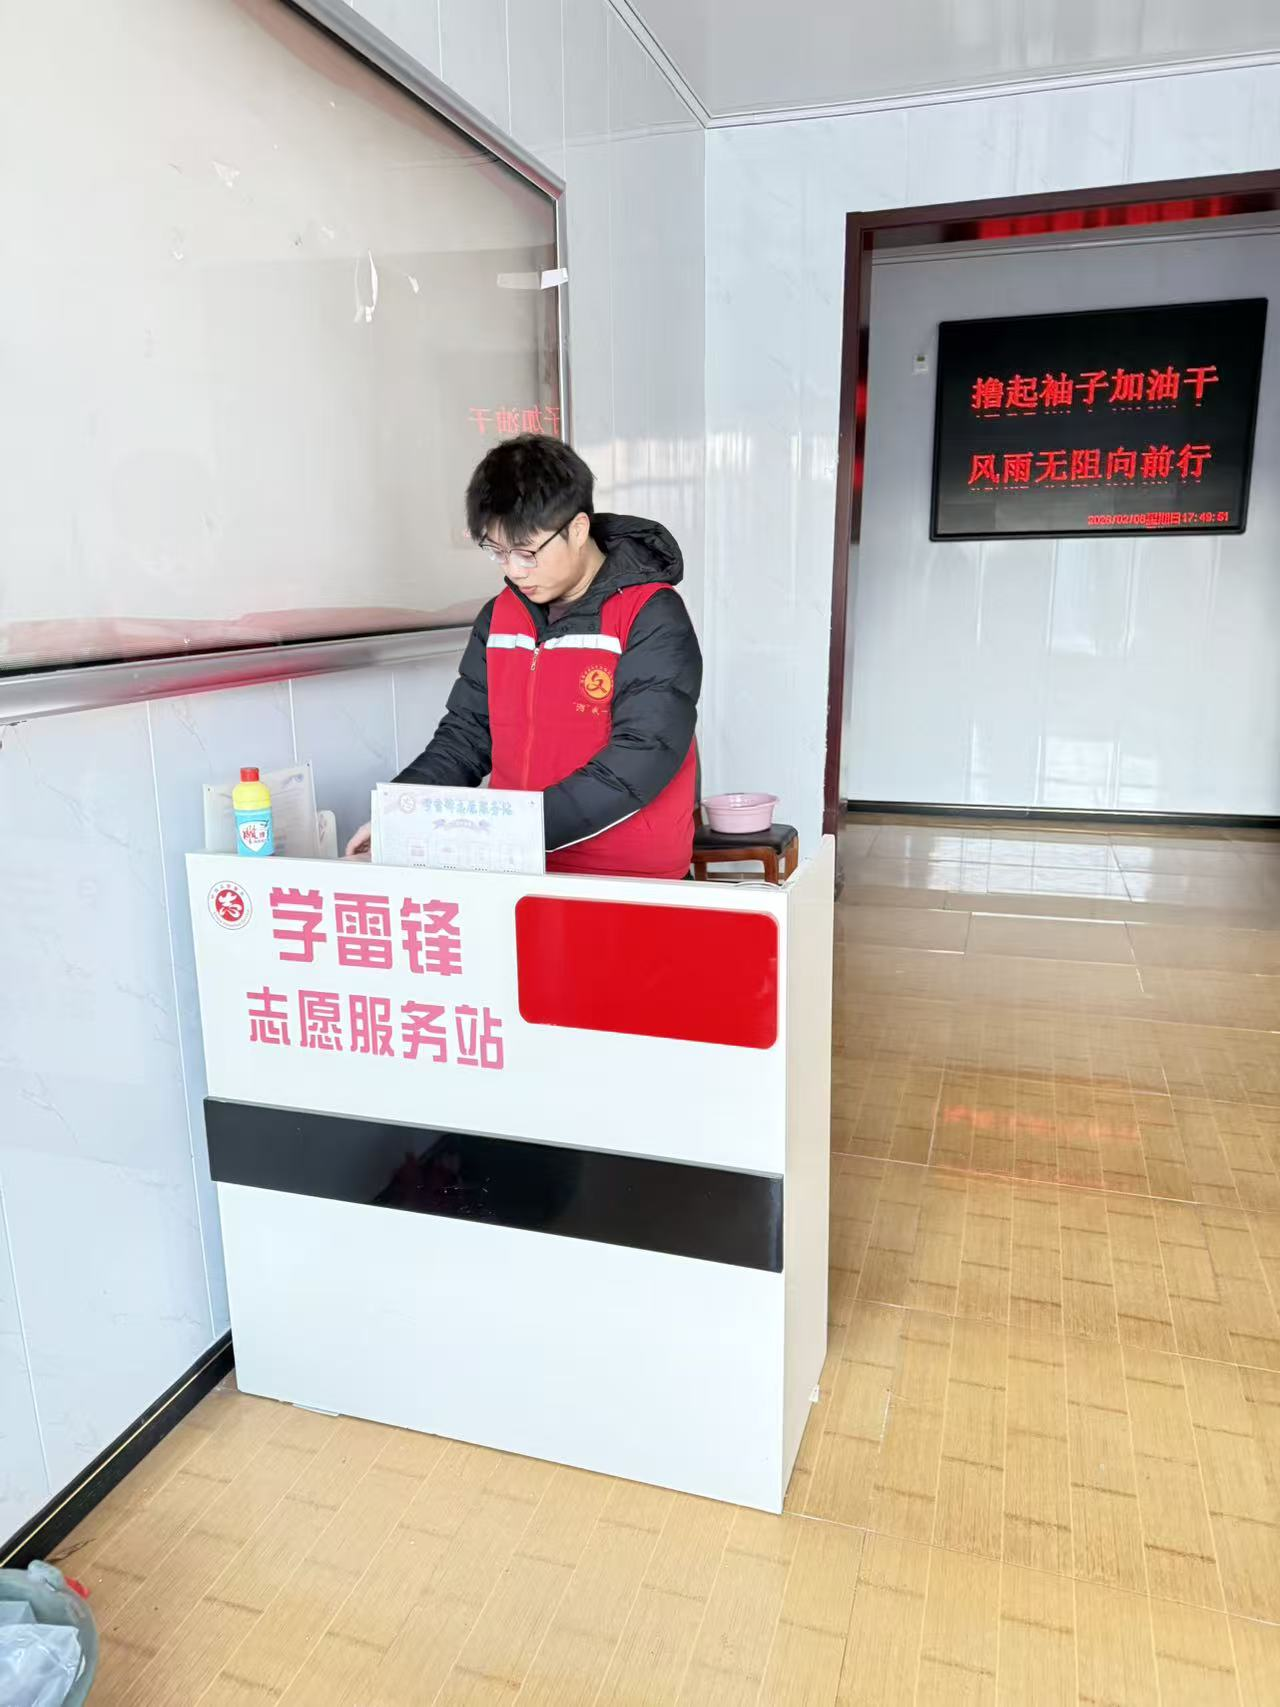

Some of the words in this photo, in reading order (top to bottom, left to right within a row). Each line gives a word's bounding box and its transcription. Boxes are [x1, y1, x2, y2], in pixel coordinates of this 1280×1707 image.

[971, 365, 1219, 417] 撸起袖子加油干
[967, 444, 1212, 490] 风雨无阻向前行
[269, 887, 463, 976] 学雷锋
[246, 986, 504, 1069] 志愿服务站
